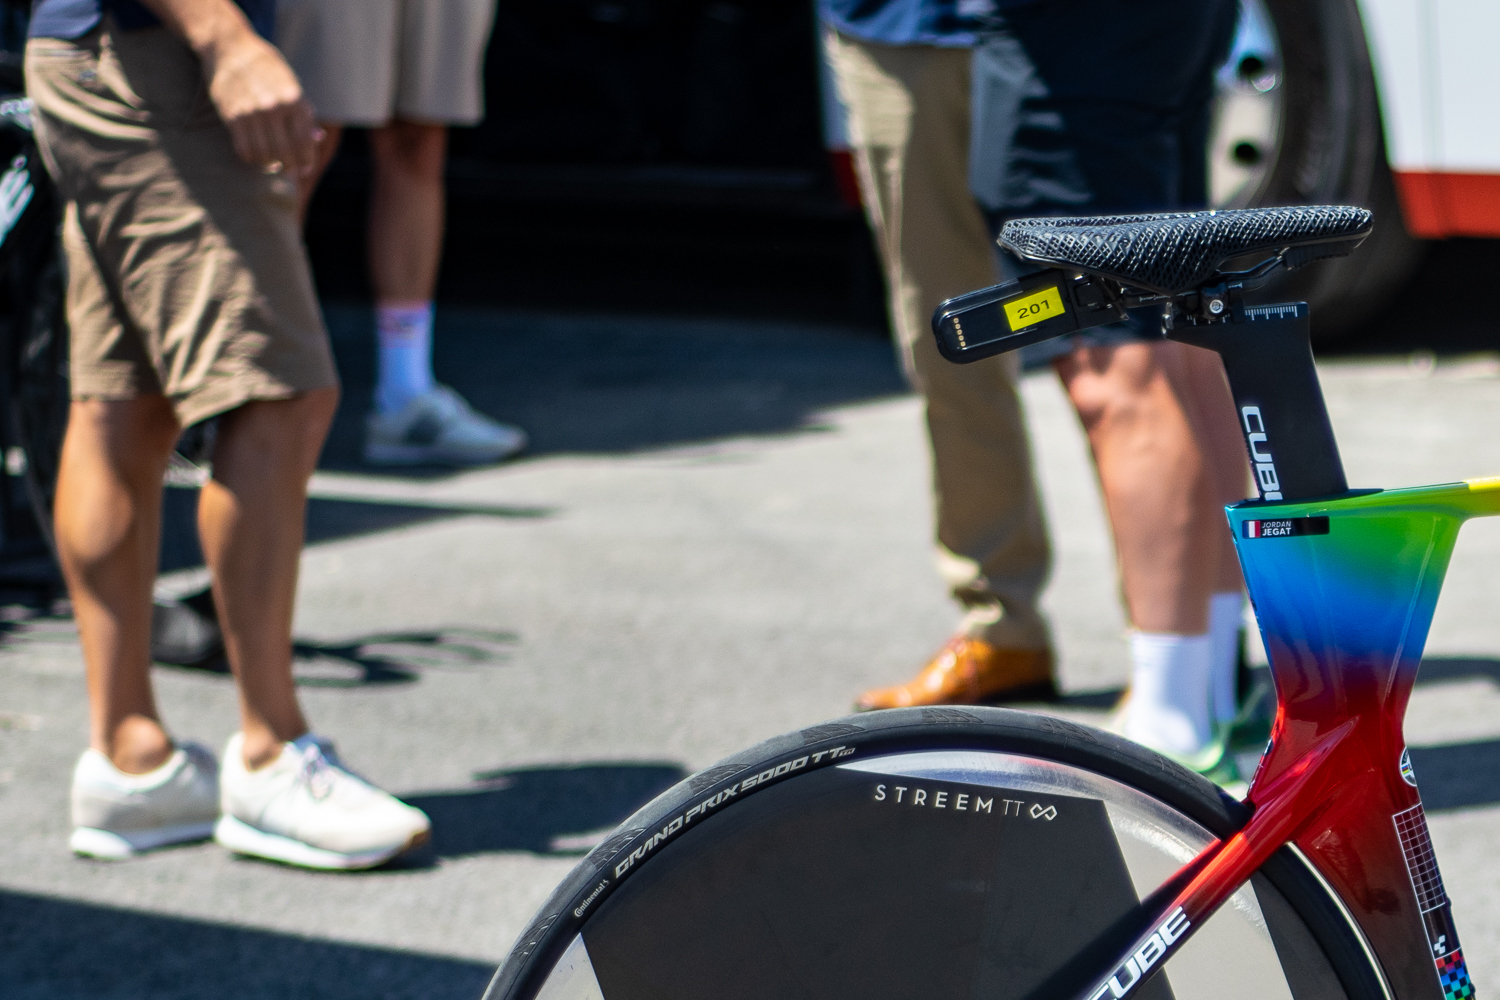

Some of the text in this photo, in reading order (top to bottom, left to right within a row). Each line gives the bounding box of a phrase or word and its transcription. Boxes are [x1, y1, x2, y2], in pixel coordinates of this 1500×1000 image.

[1017, 299, 1050, 319] 201
[1262, 521, 1292, 529] JORDAN
[1262, 528, 1292, 536] JEGAT
[875, 784, 1025, 816] STREEM TT
[615, 815, 684, 879] GRAND
[685, 785, 742, 823] PRIX
[741, 756, 810, 791] 5000
